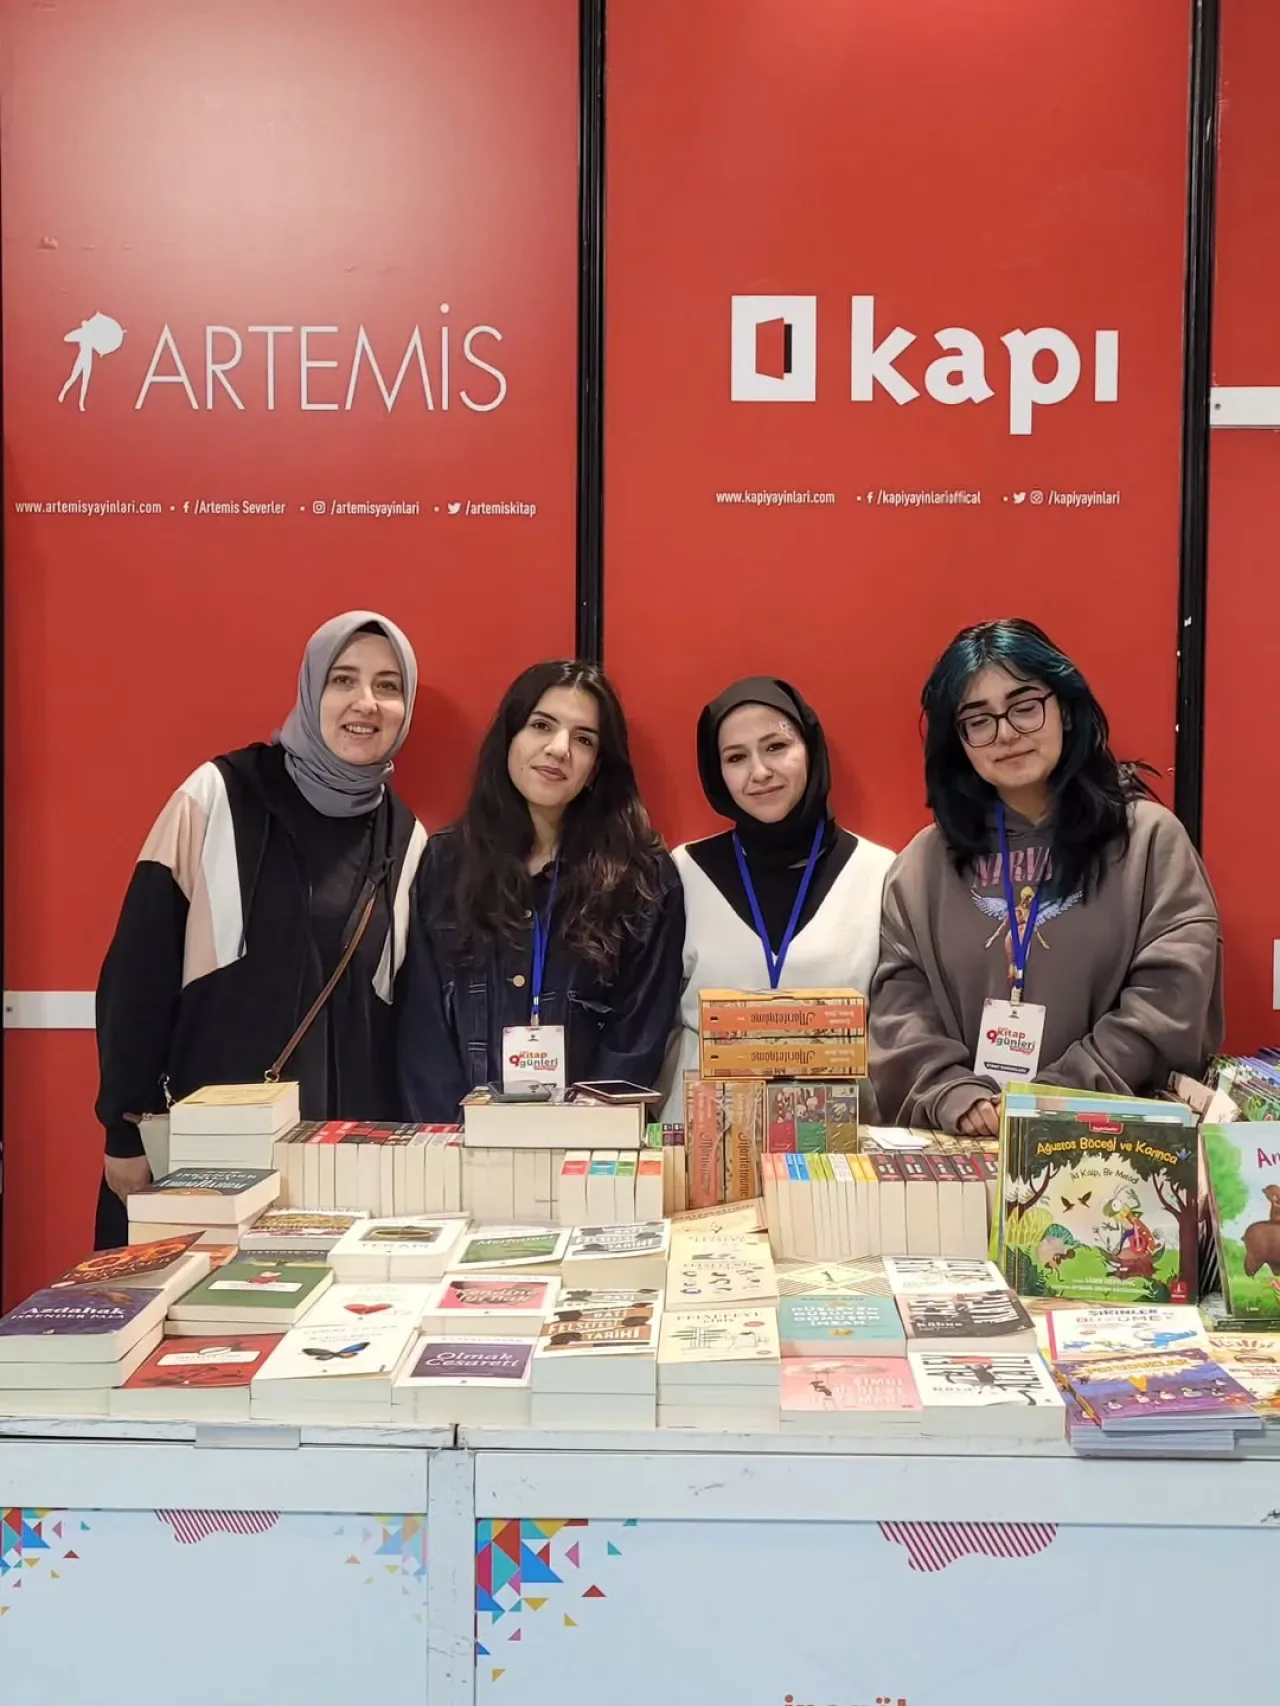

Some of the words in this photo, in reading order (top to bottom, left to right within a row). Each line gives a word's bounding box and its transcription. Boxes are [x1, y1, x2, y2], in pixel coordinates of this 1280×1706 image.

[135, 302, 508, 413] ARTEMİS
[851, 295, 1120, 435] kapı
[716, 490, 836, 507] www.kapiyayinlari.com
[1048, 491, 1120, 507] /kapiyayinlari
[15, 500, 162, 516] www.artemisyayinlari.com
[194, 500, 240, 515] /Artemis
[242, 500, 286, 515] Severler
[330, 500, 420, 517] /artemisyayinlari
[465, 501, 537, 516] /artemiskitap
[998, 1027, 1026, 1039] Kitap
[996, 1038, 1037, 1051] günleri
[519, 1051, 548, 1060] Kitap
[519, 1058, 558, 1068] günleri
[1120, 1141, 1133, 1151] ve
